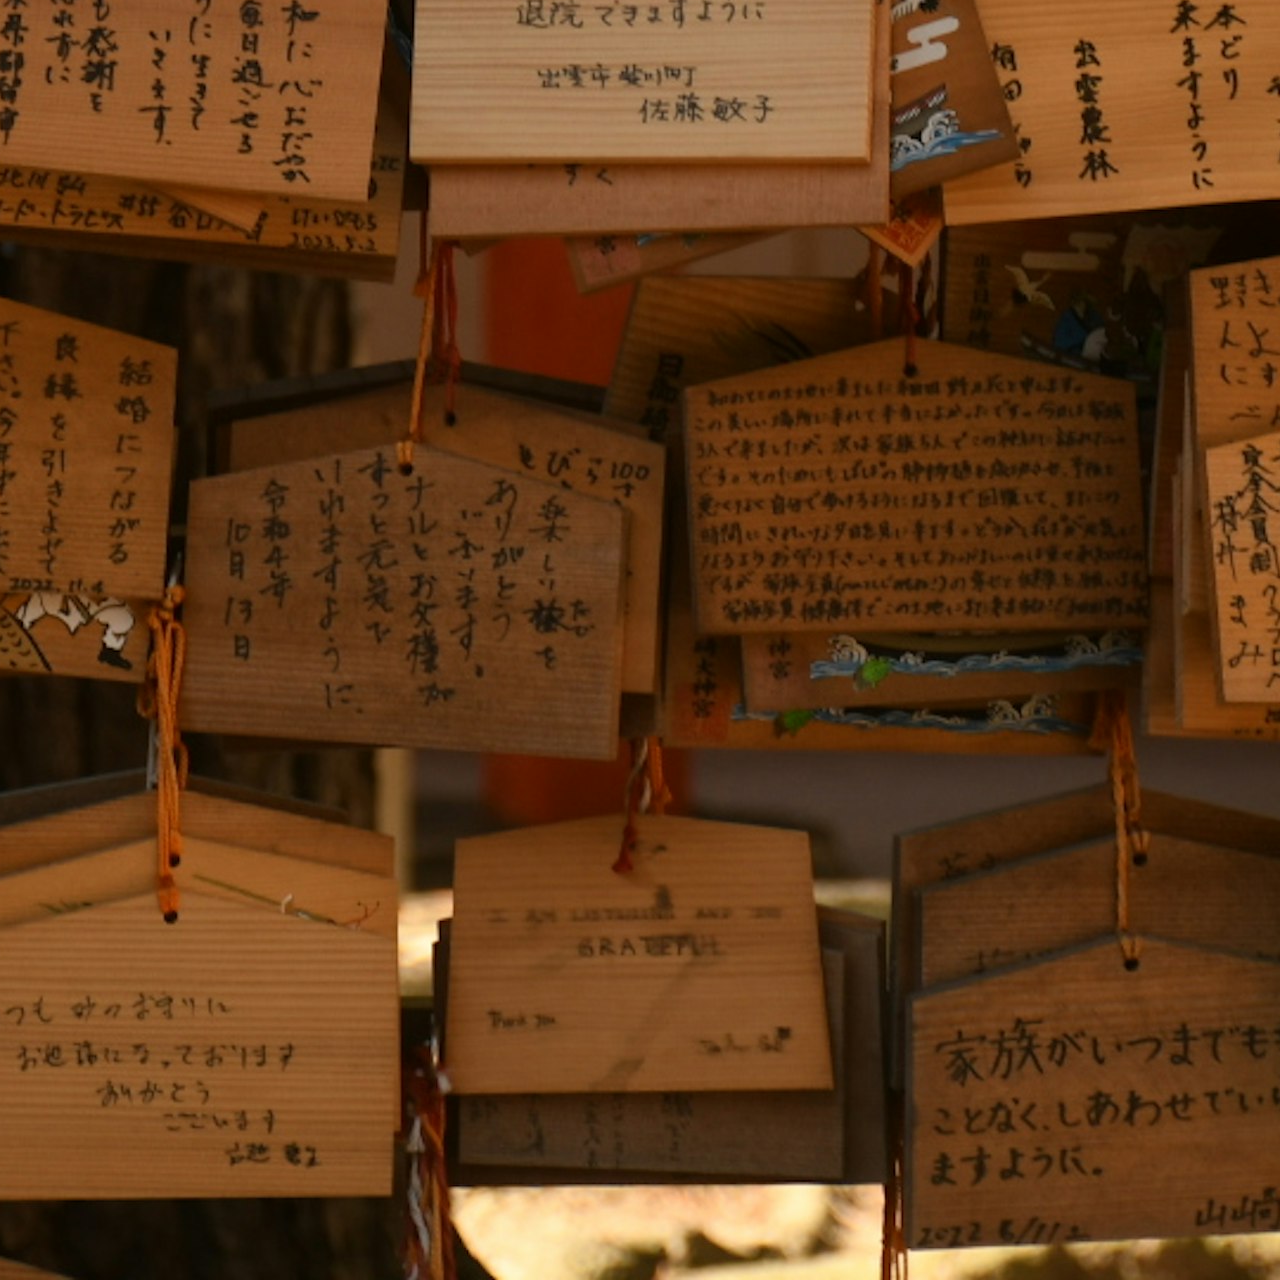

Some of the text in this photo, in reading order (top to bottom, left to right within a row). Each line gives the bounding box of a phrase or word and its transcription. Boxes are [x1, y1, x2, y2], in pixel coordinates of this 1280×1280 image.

[930, 1146, 1105, 1186] ますように。
